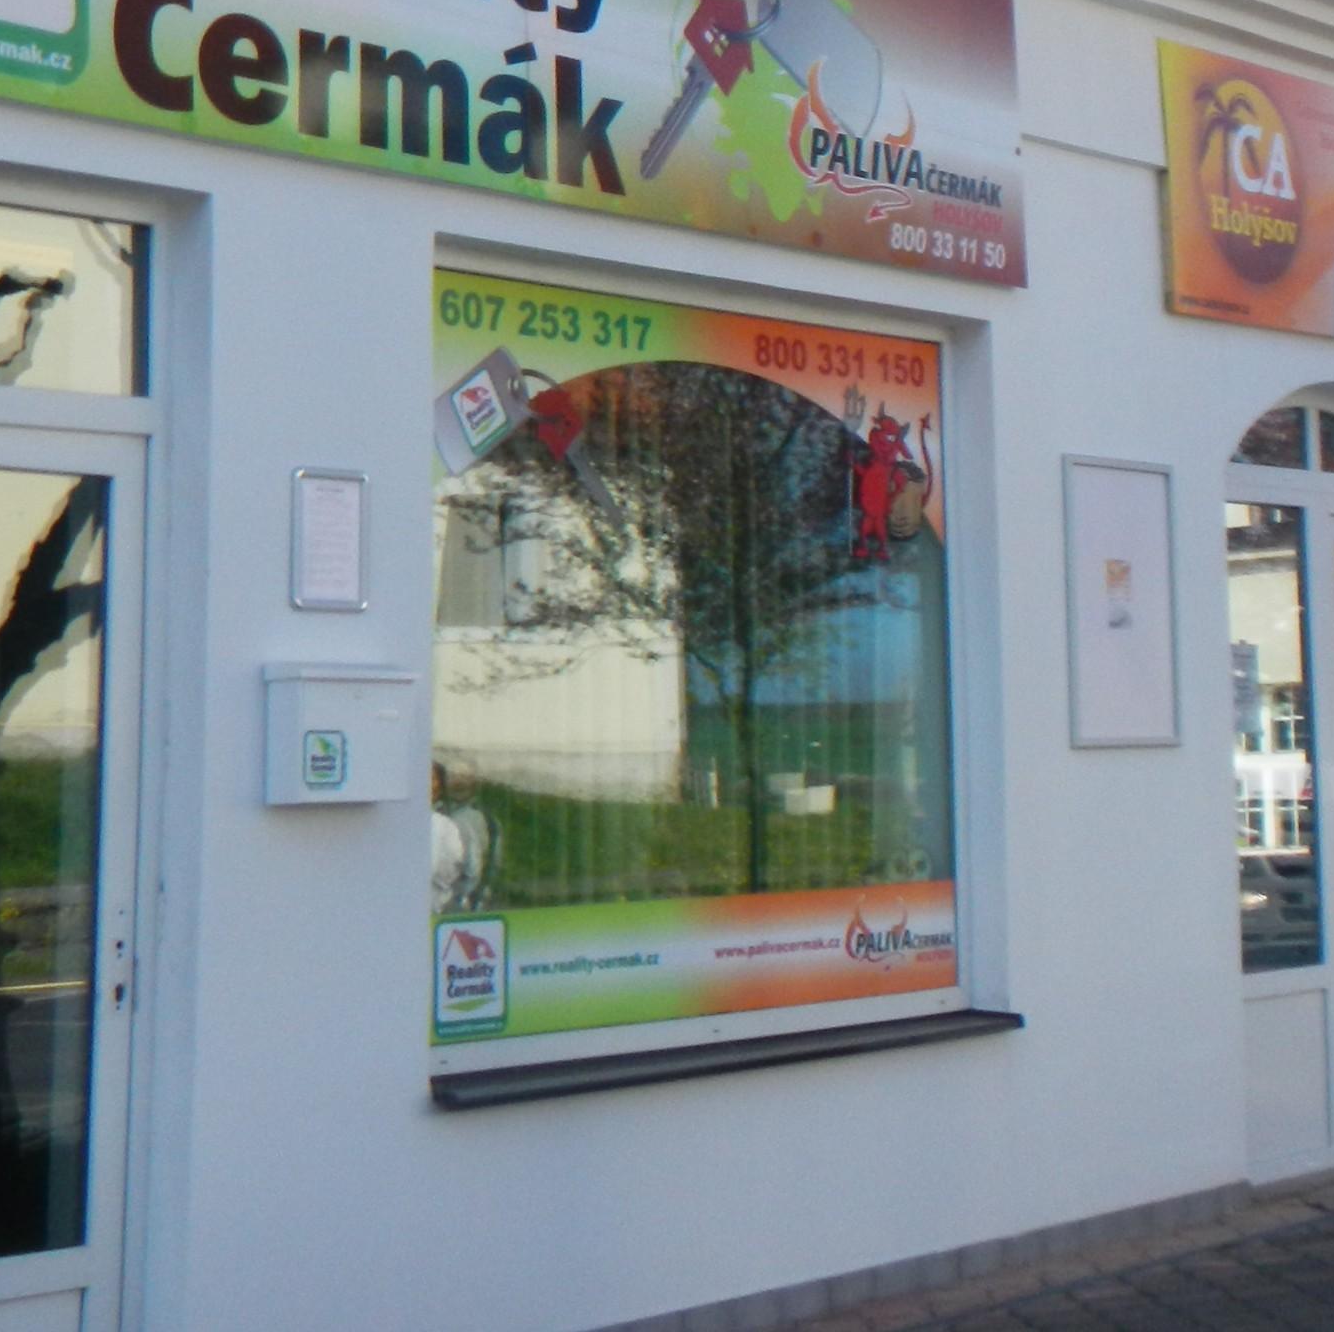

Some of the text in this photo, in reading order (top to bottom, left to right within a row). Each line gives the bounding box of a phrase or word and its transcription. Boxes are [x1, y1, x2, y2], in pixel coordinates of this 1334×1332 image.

[1230, 124, 1297, 200] CA
[890, 223, 1006, 269] 800 33 11 50
[1208, 193, 1298, 247] Holýšov
[439, 288, 652, 352] 607 253 317
[755, 334, 925, 388] 800 331 150
[446, 962, 495, 980] Reality
